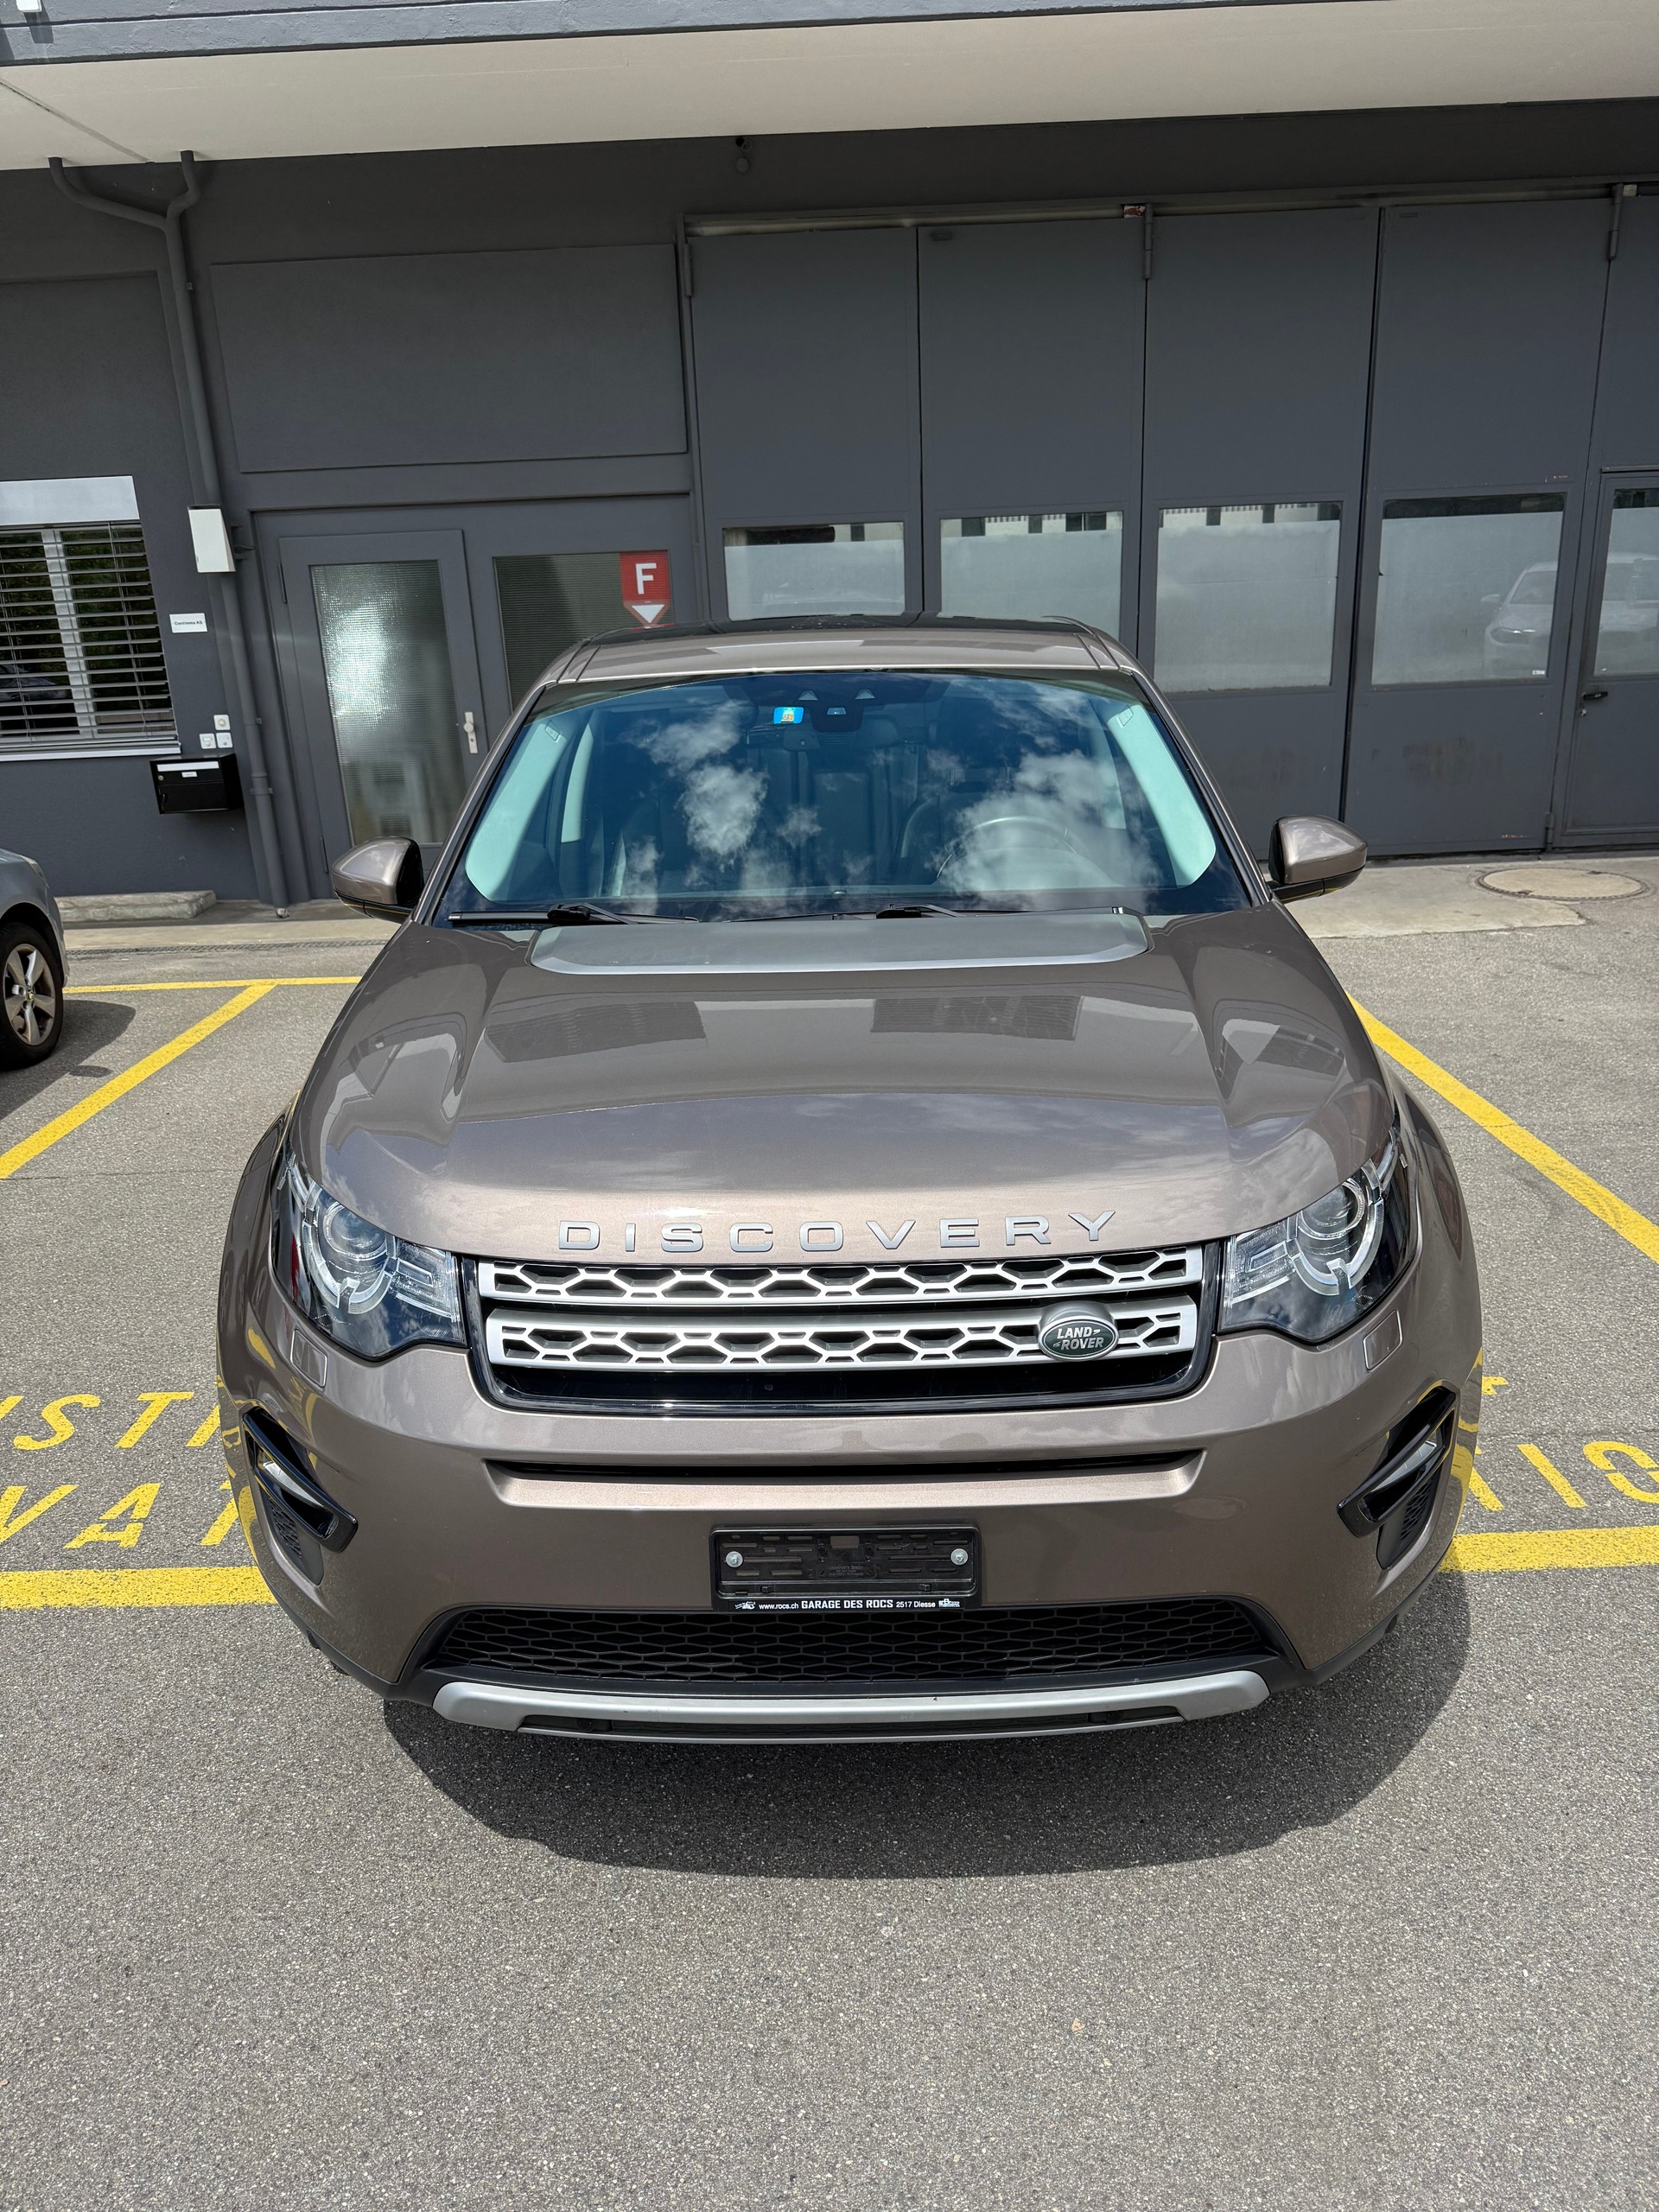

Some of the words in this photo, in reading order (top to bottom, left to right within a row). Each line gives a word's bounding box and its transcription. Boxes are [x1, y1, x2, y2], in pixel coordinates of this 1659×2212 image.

[635, 563, 657, 594] F
[558, 1211, 1116, 1253] DISCOVERY
[1057, 1326, 1092, 1339] LAND
[1060, 1337, 1104, 1351] ROVER
[801, 1600, 841, 1609] GARAGE
[843, 1599, 863, 1609] DES
[866, 1599, 893, 1608] ROCS
